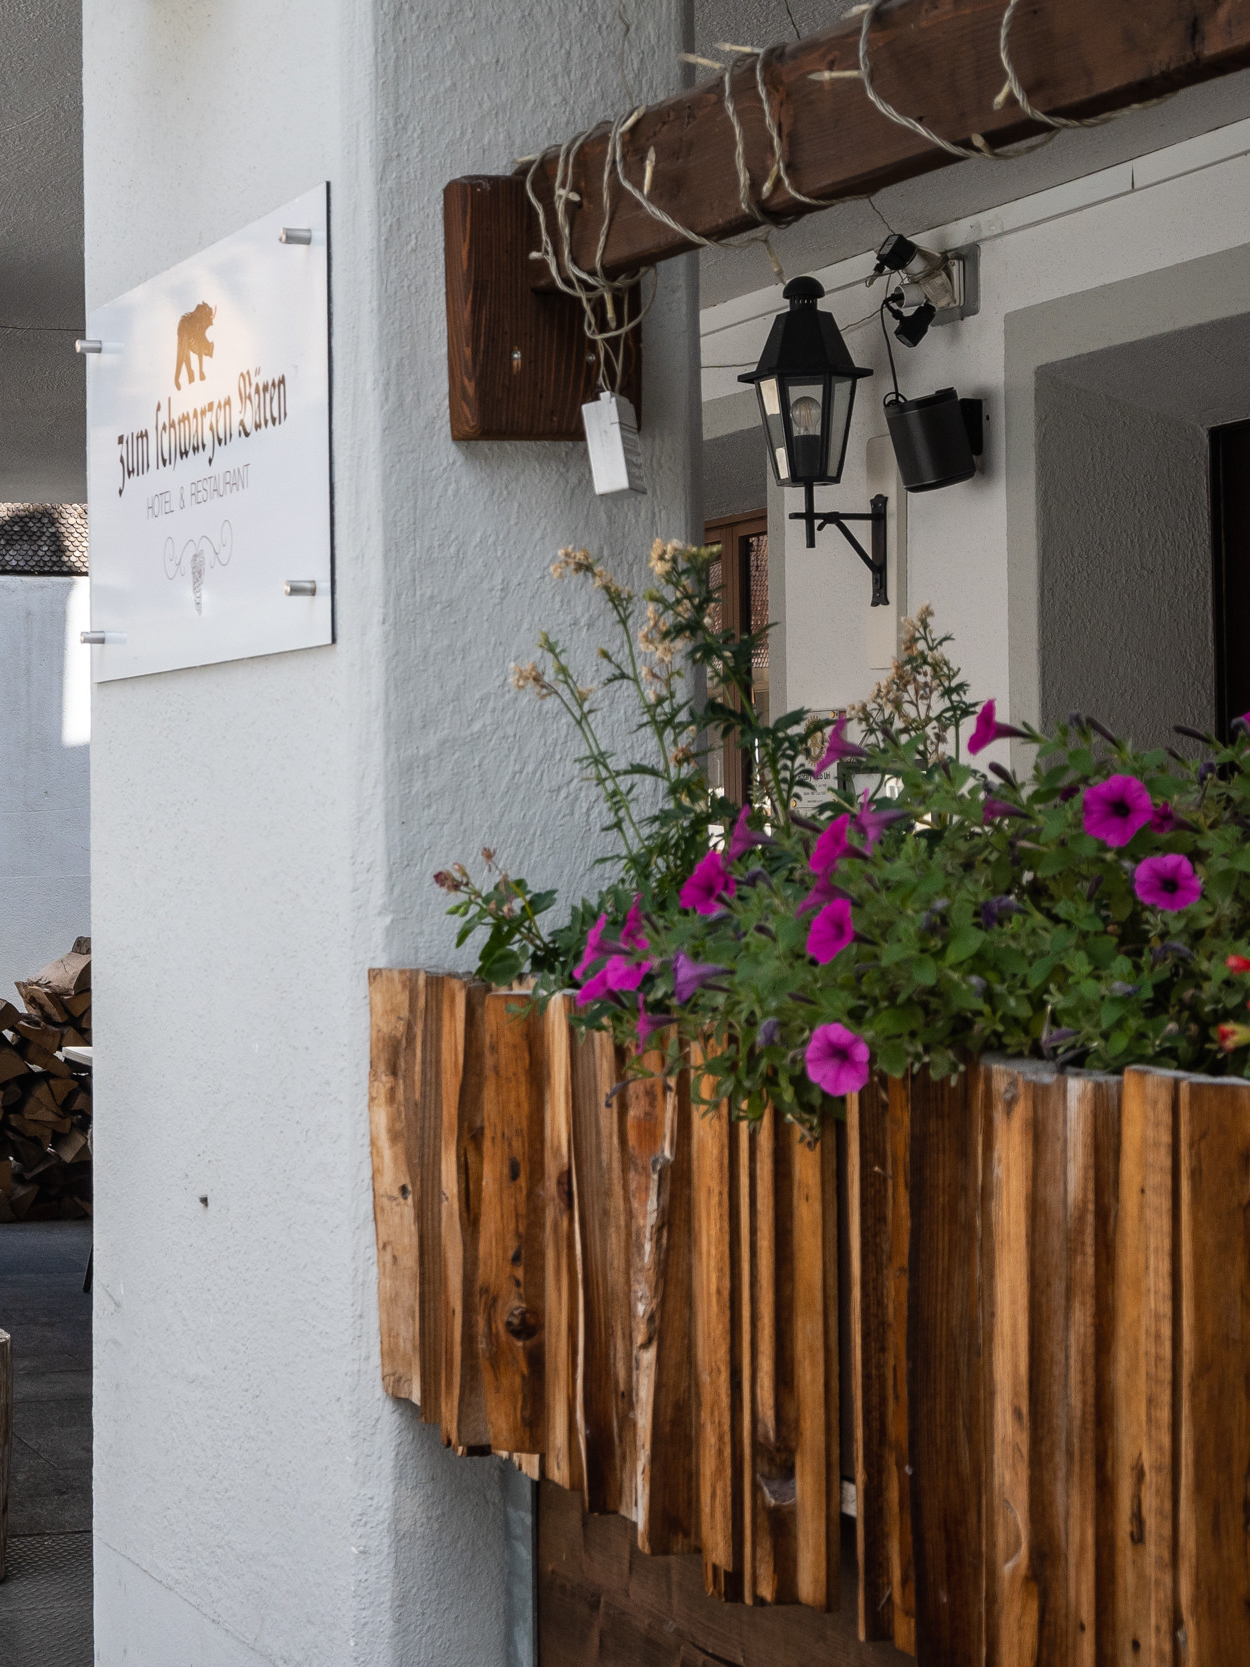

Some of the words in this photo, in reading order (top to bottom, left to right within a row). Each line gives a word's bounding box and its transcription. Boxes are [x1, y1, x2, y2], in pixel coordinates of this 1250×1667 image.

[117, 428, 150, 498] zum
[238, 366, 288, 438] Bären
[146, 490, 175, 521] HOTEL
[178, 486, 186, 510] &
[190, 463, 251, 507] RESTAURANT
